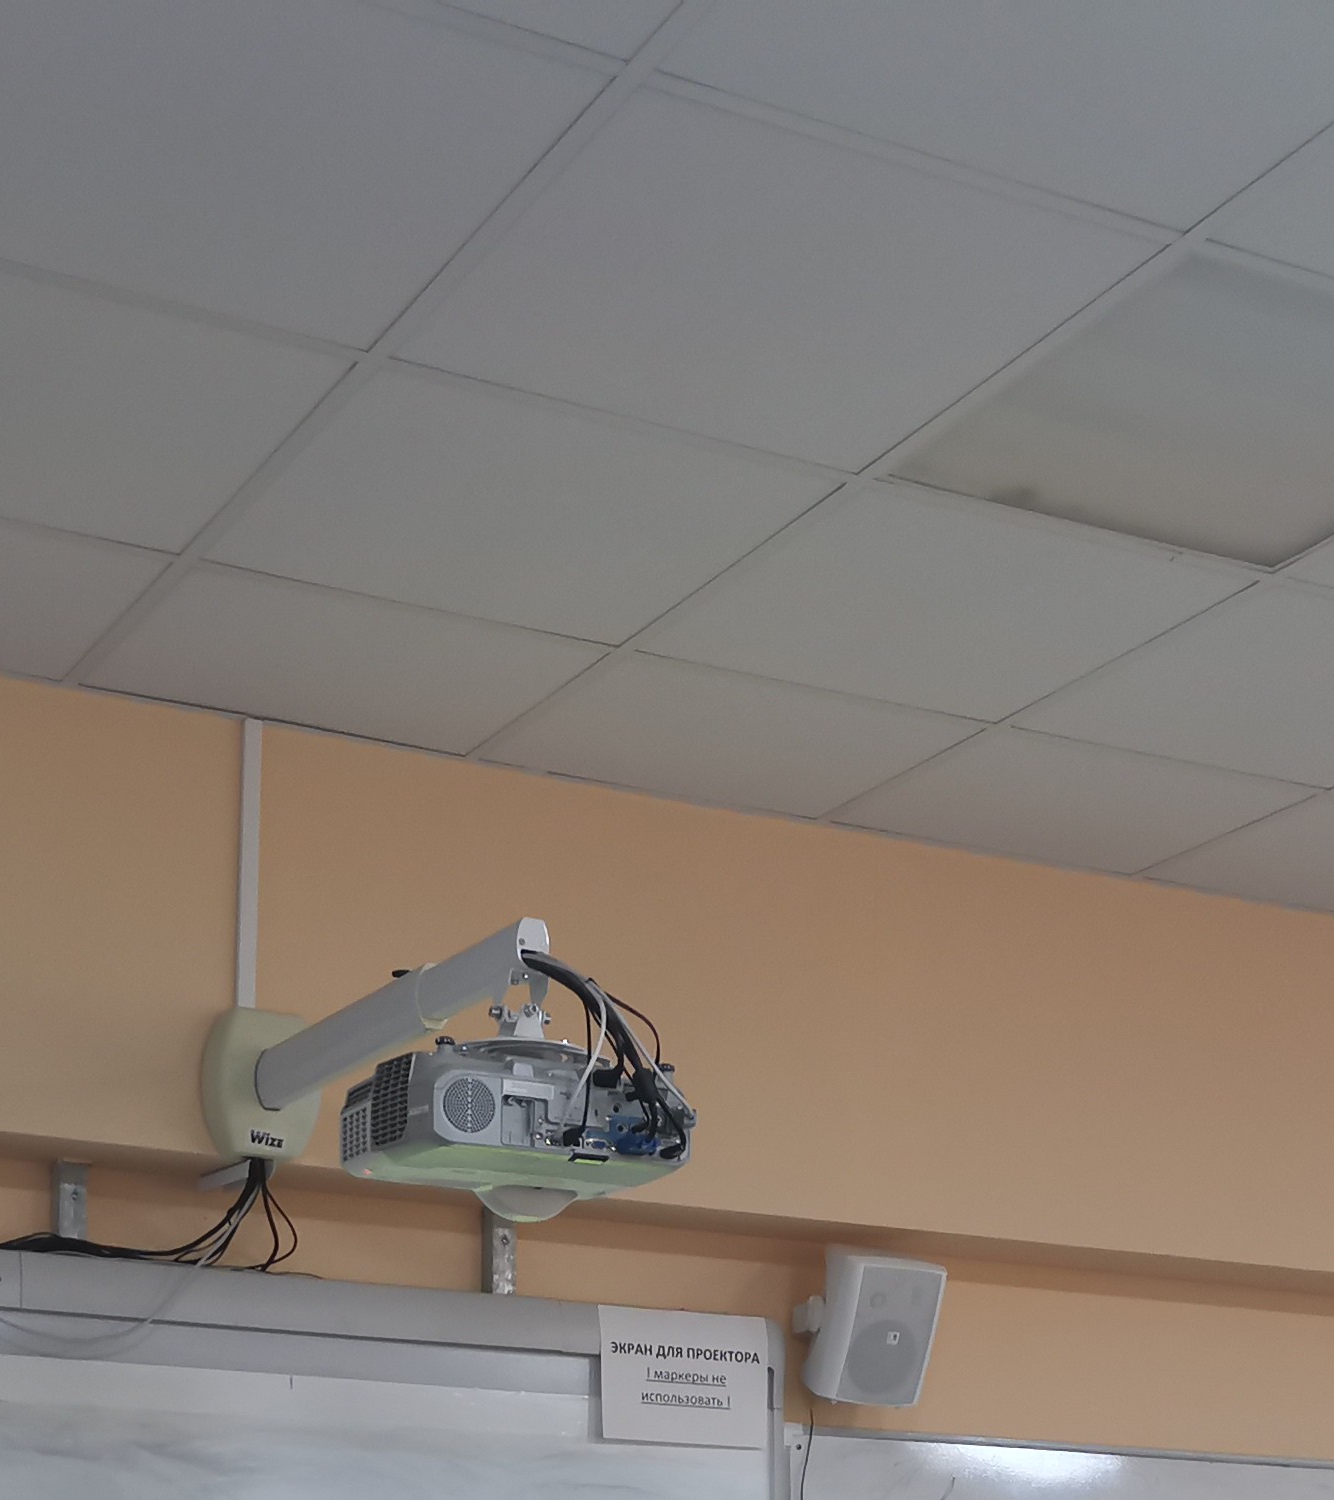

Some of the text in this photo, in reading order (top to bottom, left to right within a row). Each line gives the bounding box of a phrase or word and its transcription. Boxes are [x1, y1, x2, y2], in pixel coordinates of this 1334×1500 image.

[610, 1341, 761, 1365] ЭКРАН ДЛЯ ПРОЕКТОРА
[653, 1369, 709, 1385] маркеры
[712, 1374, 727, 1385] не
[641, 1391, 723, 1407] использовать
